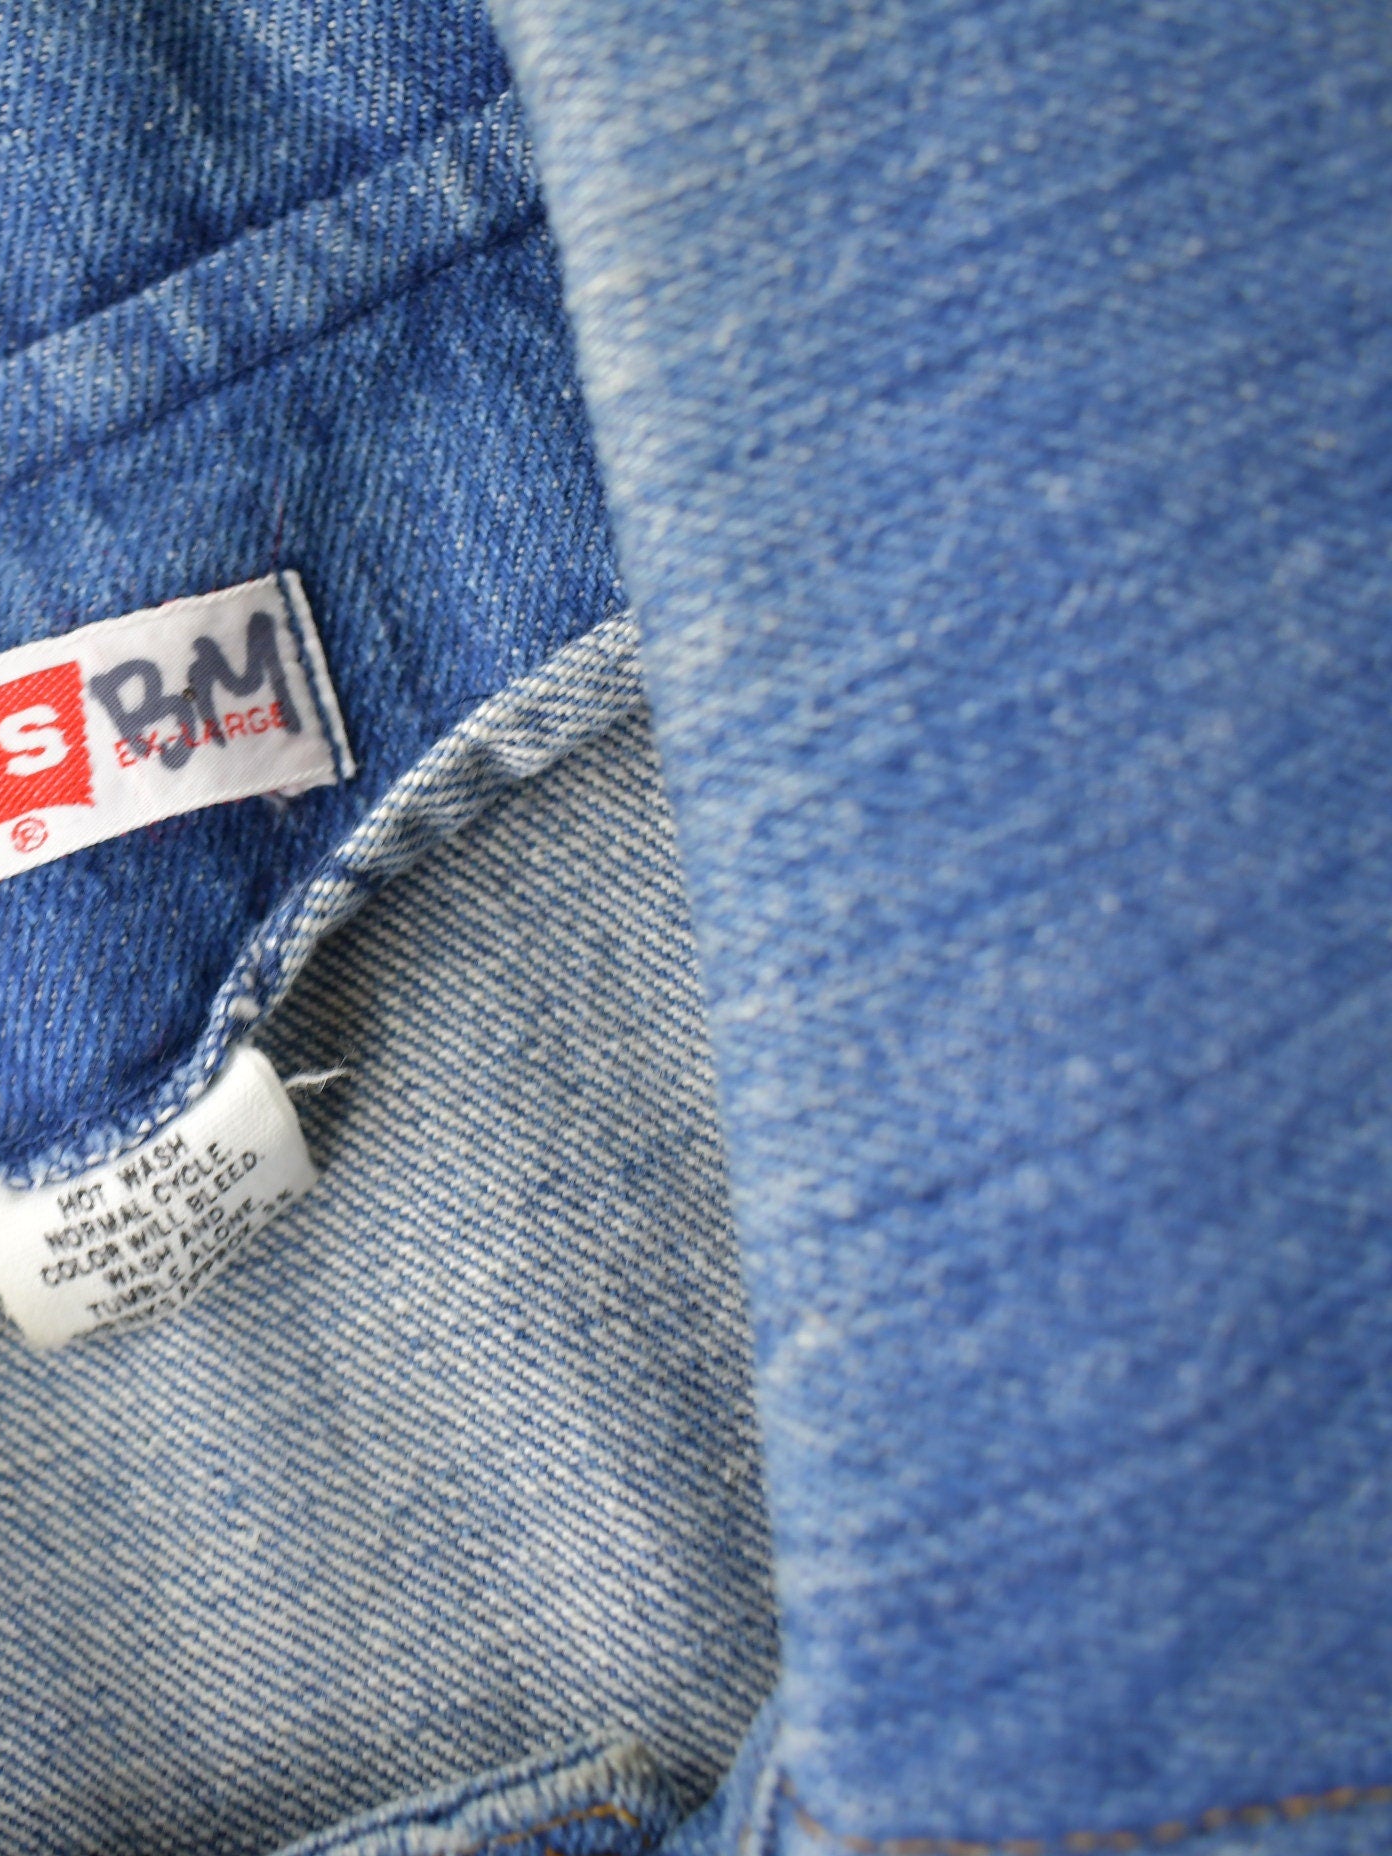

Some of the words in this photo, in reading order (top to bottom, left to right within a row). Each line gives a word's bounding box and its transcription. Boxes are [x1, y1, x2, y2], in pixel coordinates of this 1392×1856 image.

[56, 1184, 105, 1220] HOT
[117, 1133, 188, 1190] WASH
[40, 1242, 124, 1287] COLOR
[125, 1209, 186, 1251] WILL
[43, 1201, 151, 1255] NORMAL
[104, 1244, 174, 1288] WASH
[179, 1206, 225, 1249] AND
[87, 1264, 185, 1319] TUMBLE
